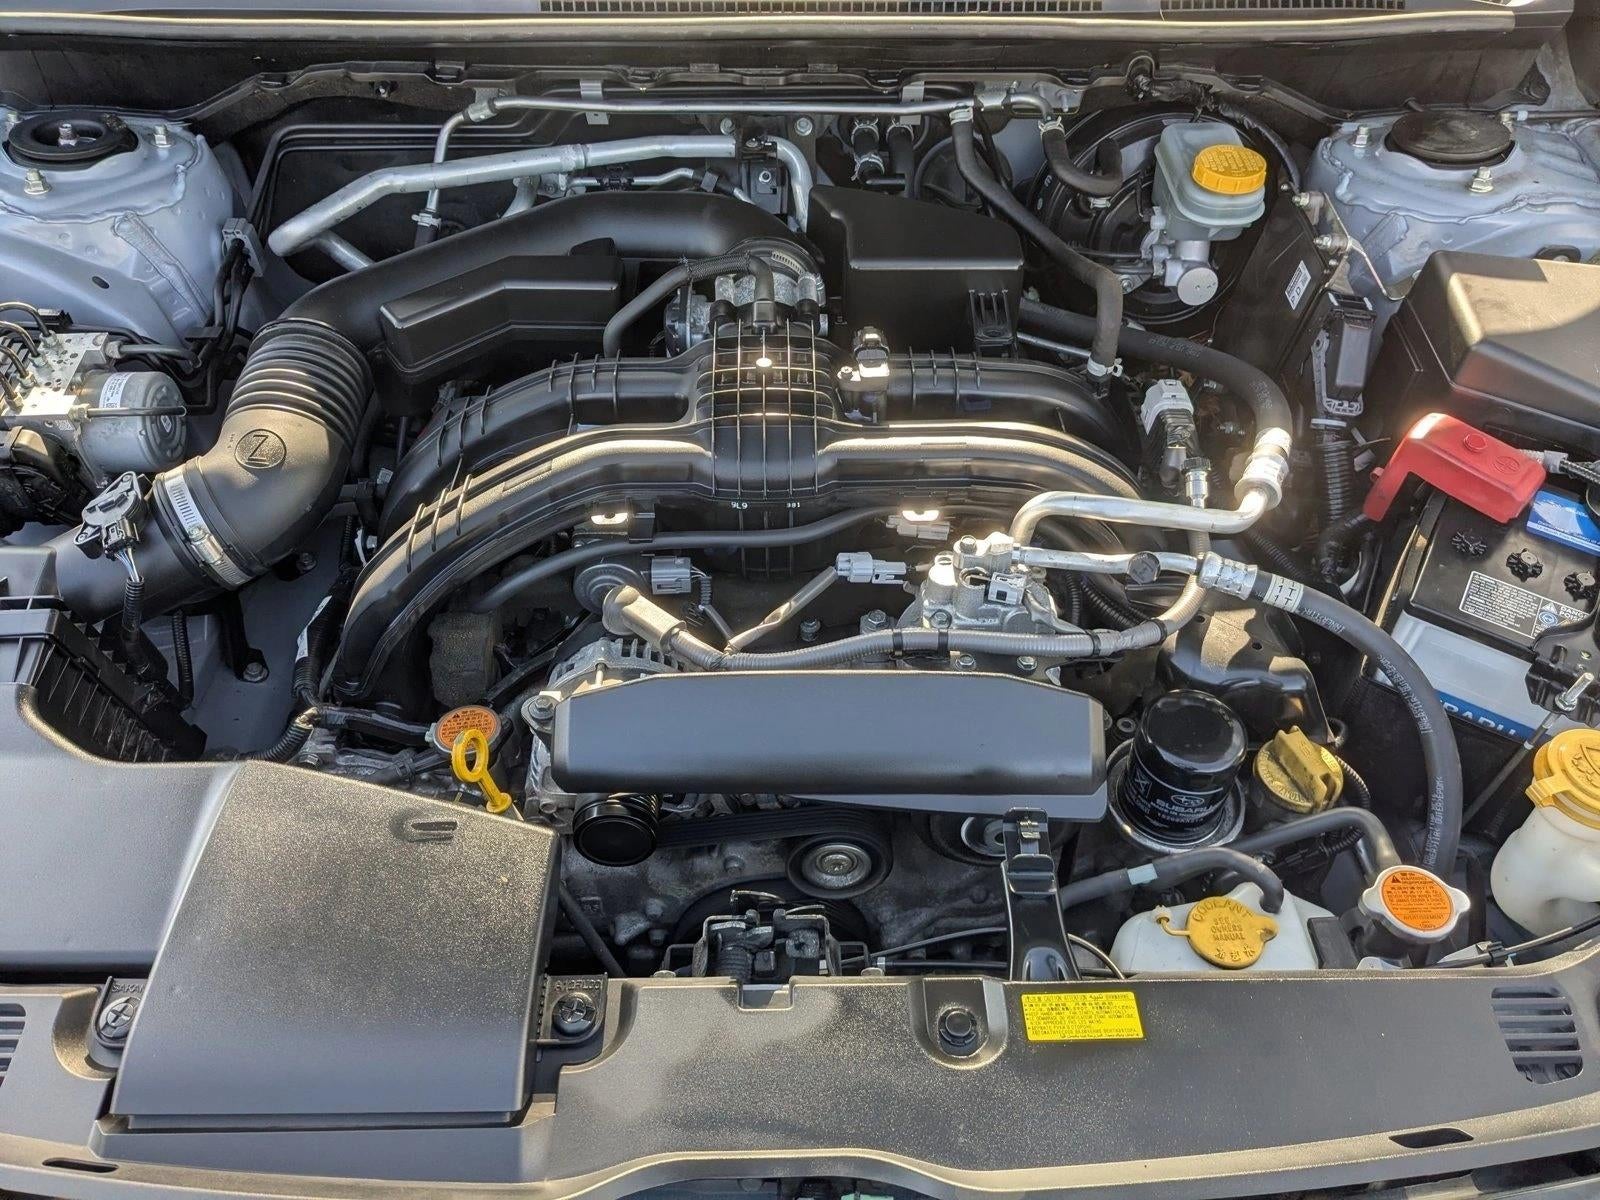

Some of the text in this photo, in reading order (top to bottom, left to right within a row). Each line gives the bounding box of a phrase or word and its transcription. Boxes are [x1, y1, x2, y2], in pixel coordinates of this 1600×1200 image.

[1560, 605, 1590, 619] DANG
[1156, 798, 1215, 813] SUBARU
[1192, 899, 1254, 922] COOLANT
[1213, 932, 1246, 941] MANUAL
